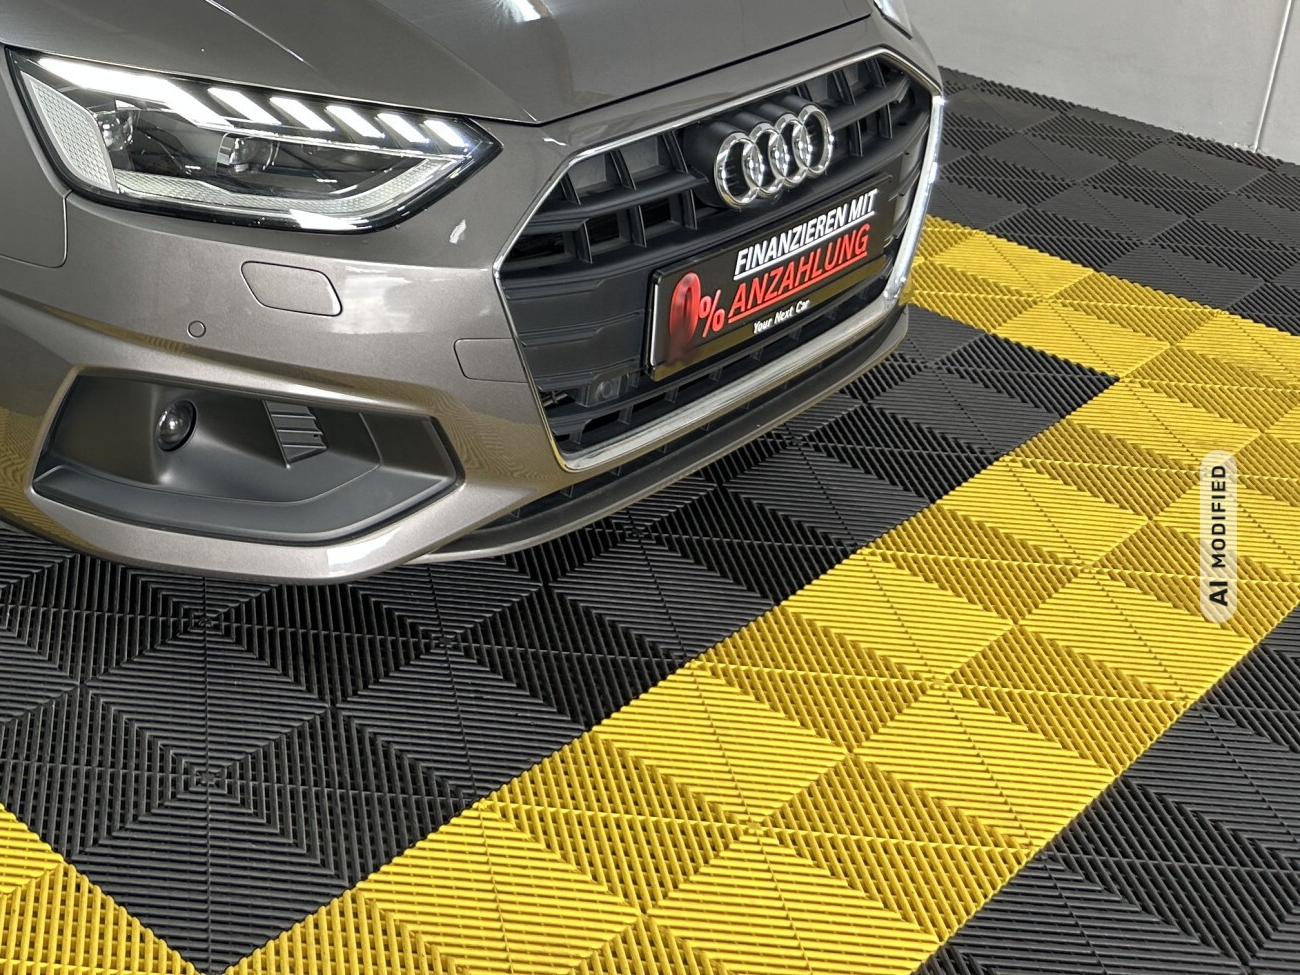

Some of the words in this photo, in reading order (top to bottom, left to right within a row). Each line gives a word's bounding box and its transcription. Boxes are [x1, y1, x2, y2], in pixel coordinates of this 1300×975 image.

[728, 223, 871, 319] ANZAHLUNG
[734, 203, 848, 275] FINANZIEREN
[848, 188, 879, 221] MIT
[753, 318, 773, 334] Your
[774, 307, 794, 323] Next
[795, 298, 810, 313] Car
